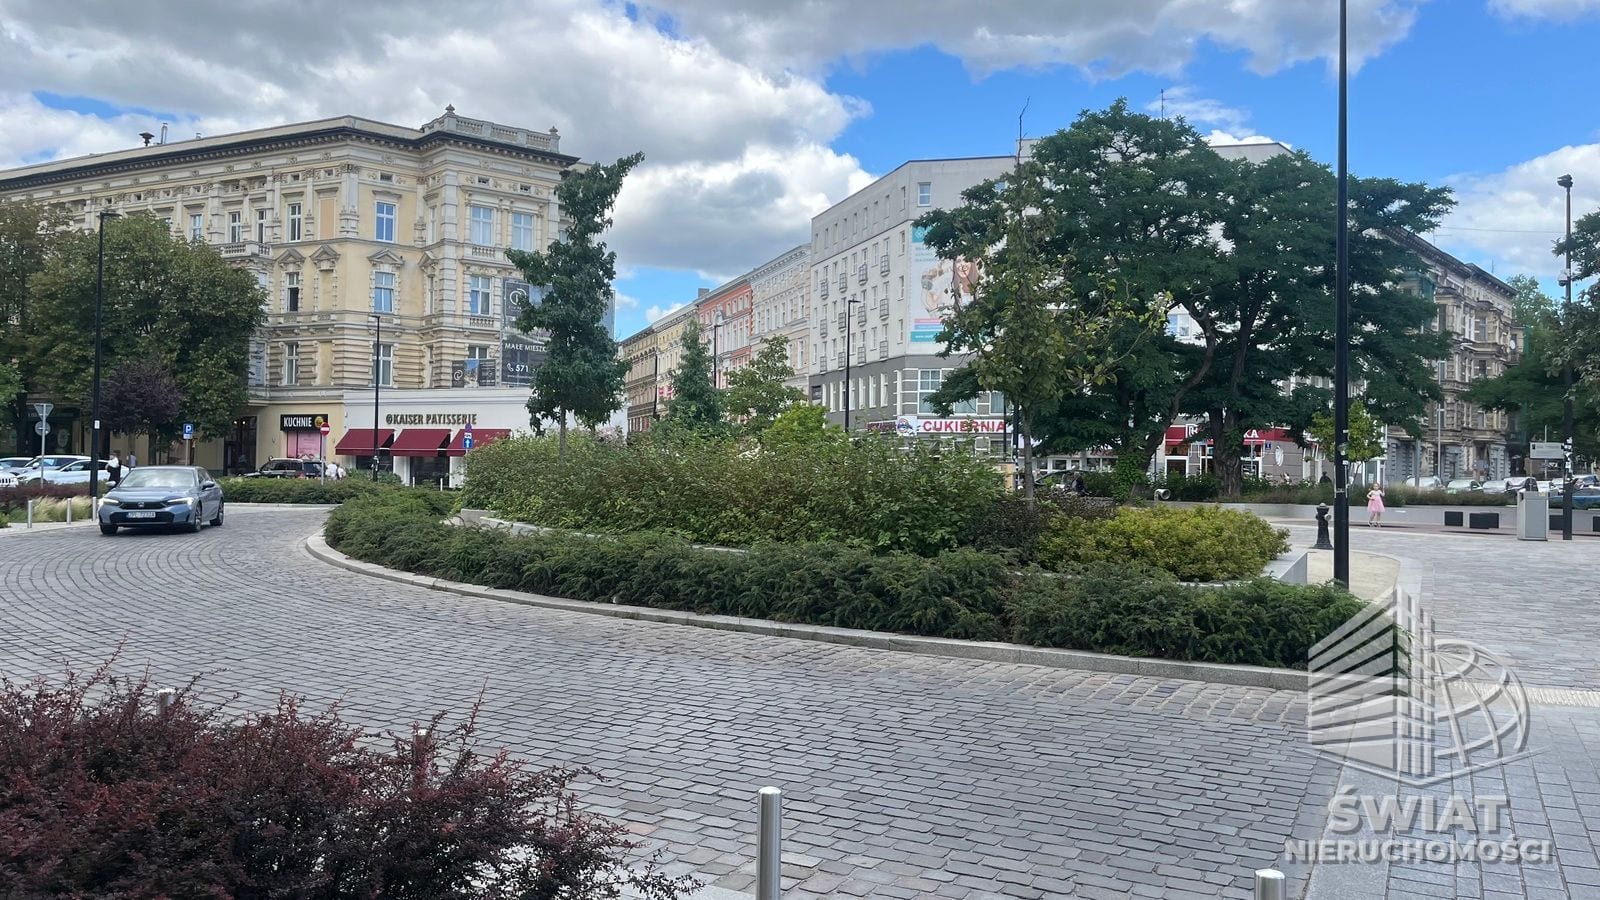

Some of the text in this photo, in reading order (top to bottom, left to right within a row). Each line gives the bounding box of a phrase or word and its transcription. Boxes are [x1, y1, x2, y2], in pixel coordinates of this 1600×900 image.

[515, 364, 529, 373] 571
[283, 416, 313, 427] KUCHNIE
[393, 414, 477, 425] KAISER PATISSERIE
[922, 420, 1006, 433] CUKIERNIA
